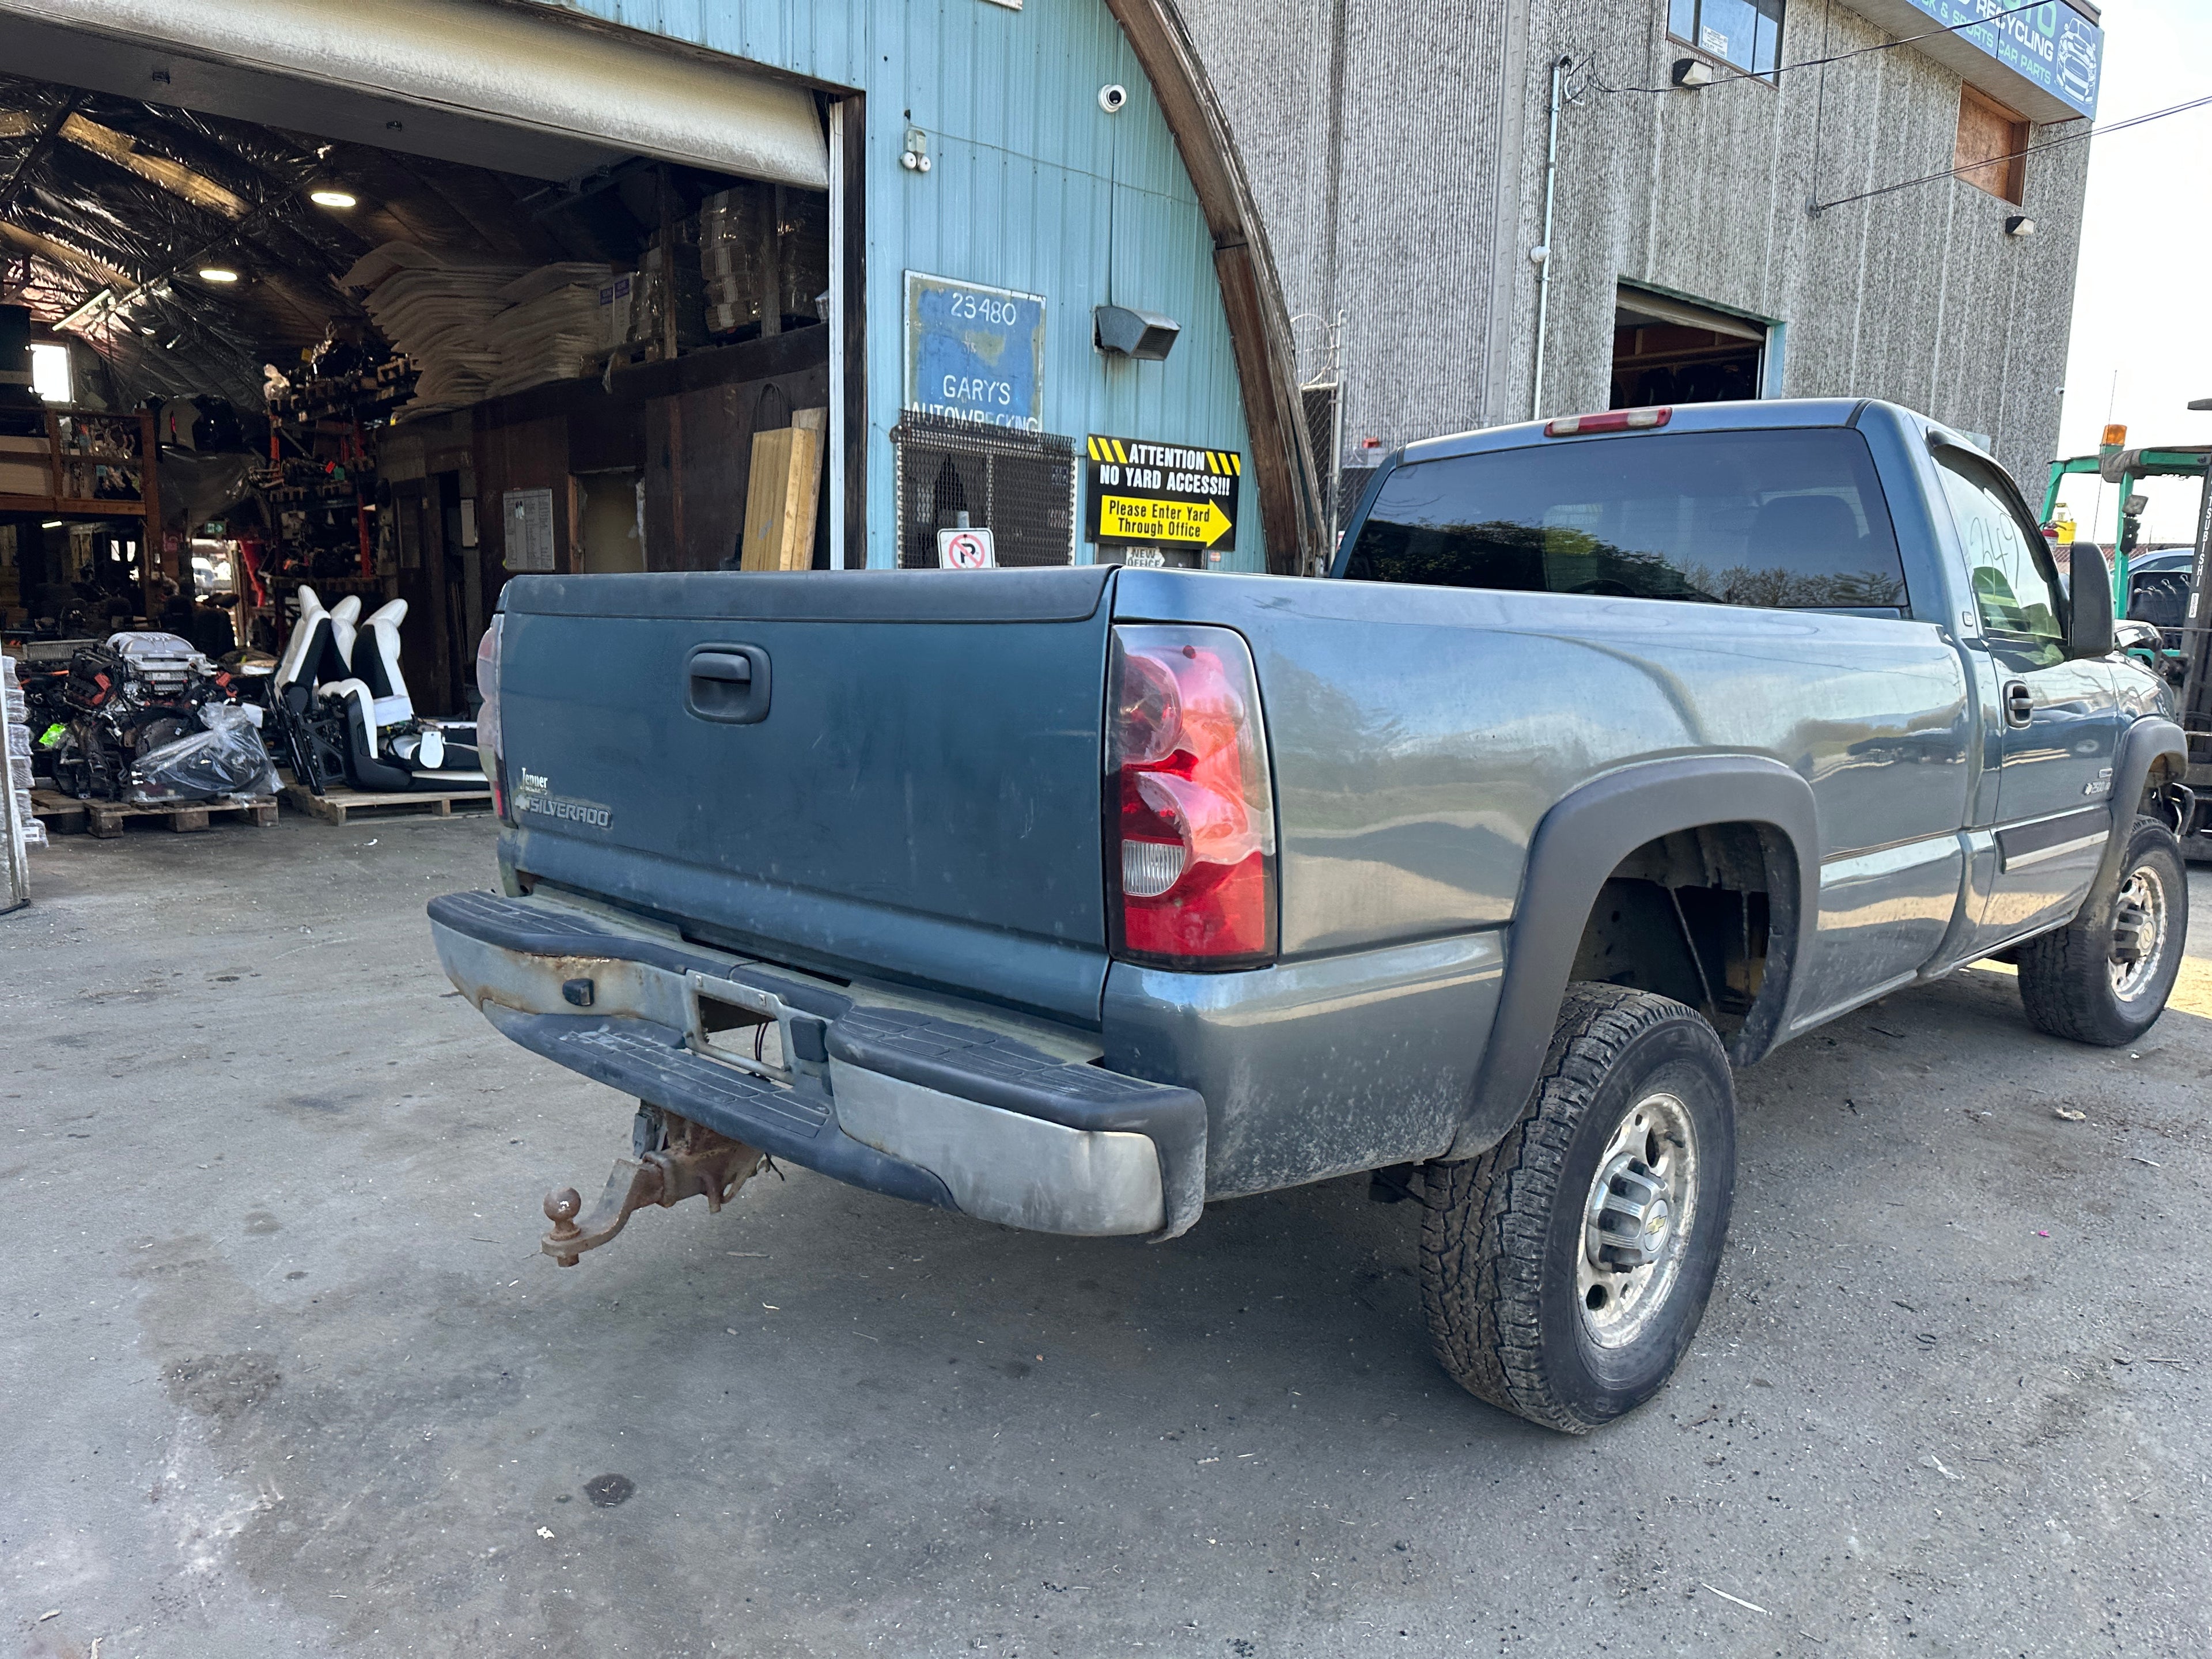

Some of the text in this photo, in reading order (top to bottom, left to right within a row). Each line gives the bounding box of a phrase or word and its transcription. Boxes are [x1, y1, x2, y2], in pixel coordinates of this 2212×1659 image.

[1976, 0, 2054, 62] RECYCLING
[1952, 9, 1994, 48] SPORTS
[1998, 39, 2018, 64] CAR
[2020, 54, 2051, 85] PARTS
[950, 292, 1017, 325] 23480
[943, 374, 1010, 405] GARY'S
[1128, 444, 1205, 471] ATTENTION
[1100, 464, 1230, 496] NO YARD ACCESS!!!
[1109, 500, 1210, 522] Please Enter Yard
[1118, 517, 1201, 537] Through Office
[2196, 479, 2212, 587] TSUBISHI
[1131, 548, 1155, 558] NEW
[530, 797, 609, 827] SILVERADO
